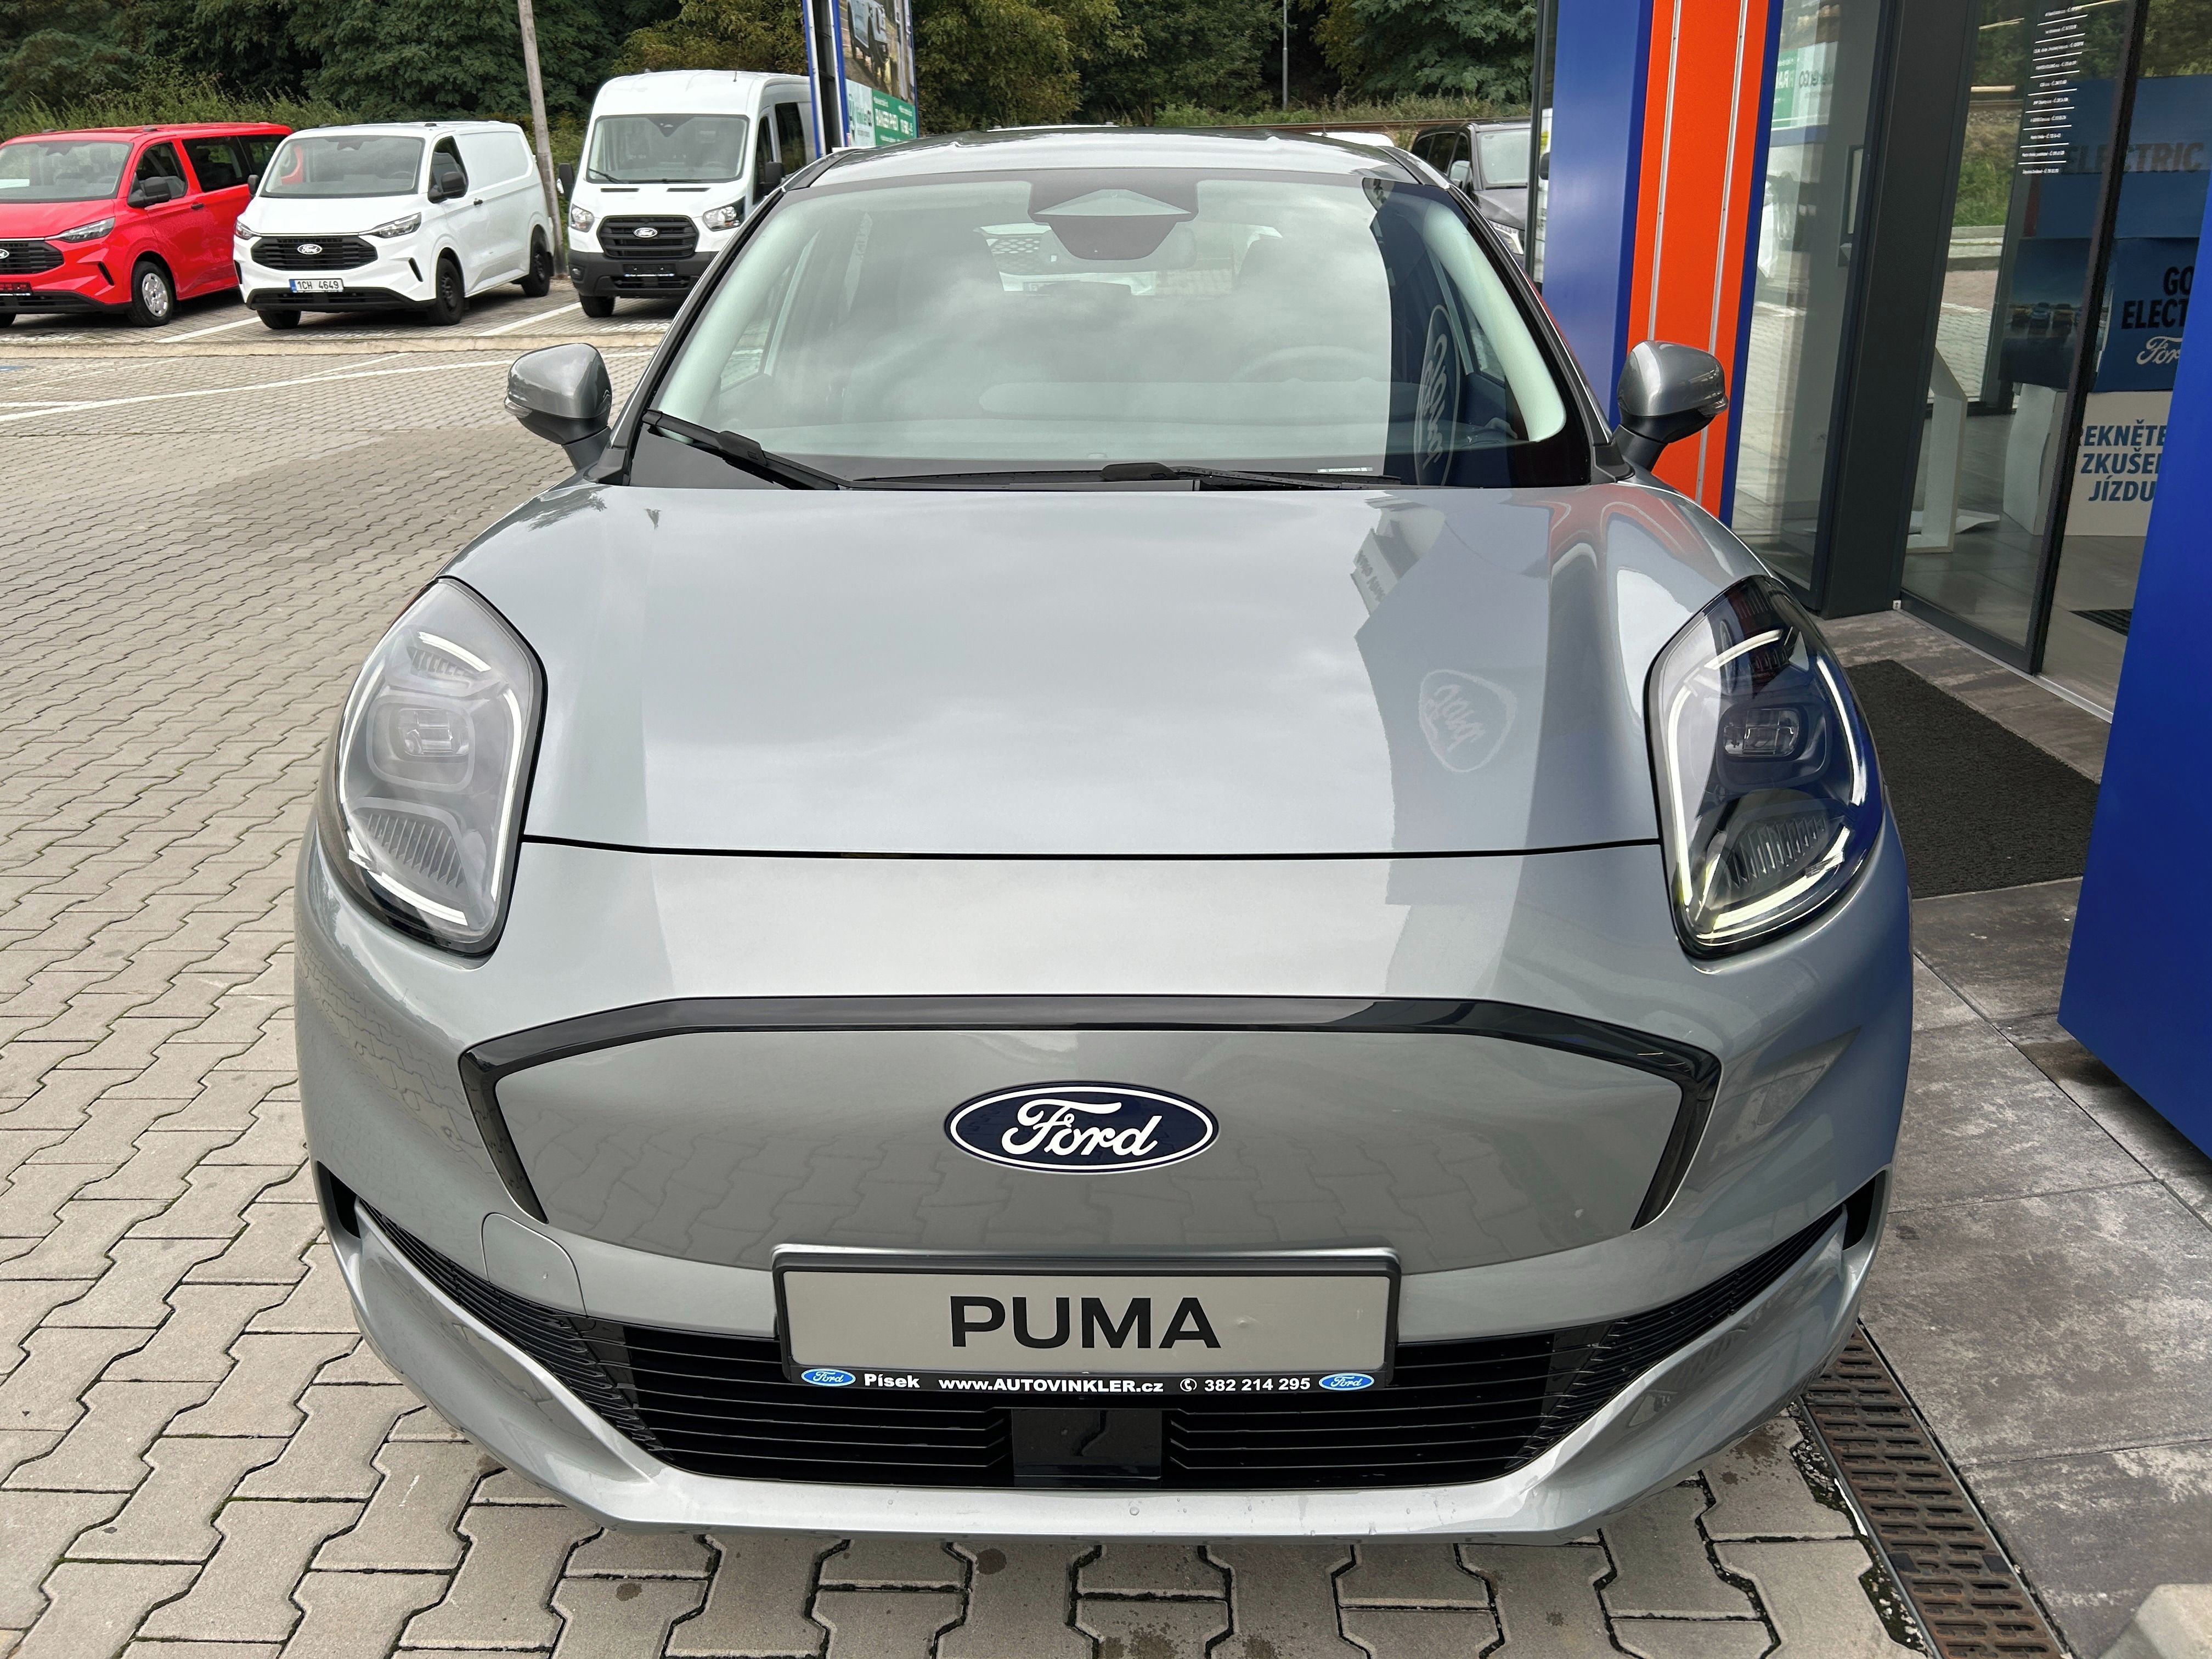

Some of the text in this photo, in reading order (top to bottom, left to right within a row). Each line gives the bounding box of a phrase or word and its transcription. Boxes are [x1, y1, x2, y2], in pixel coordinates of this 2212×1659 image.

[297, 281, 313, 290] 1CH
[318, 280, 339, 289] 4649
[2163, 266, 2194, 296] GO
[2136, 336, 2183, 365] For
[2079, 419, 2167, 447] EKNĚTE
[2088, 475, 2157, 501] JÍZDU
[1001, 1098, 1163, 1156] Ford
[950, 1295, 1222, 1349] PUMA
[812, 1371, 1362, 1393] Ford Písek www.AUTOVINKLER.cz 382 214 295 Ford
